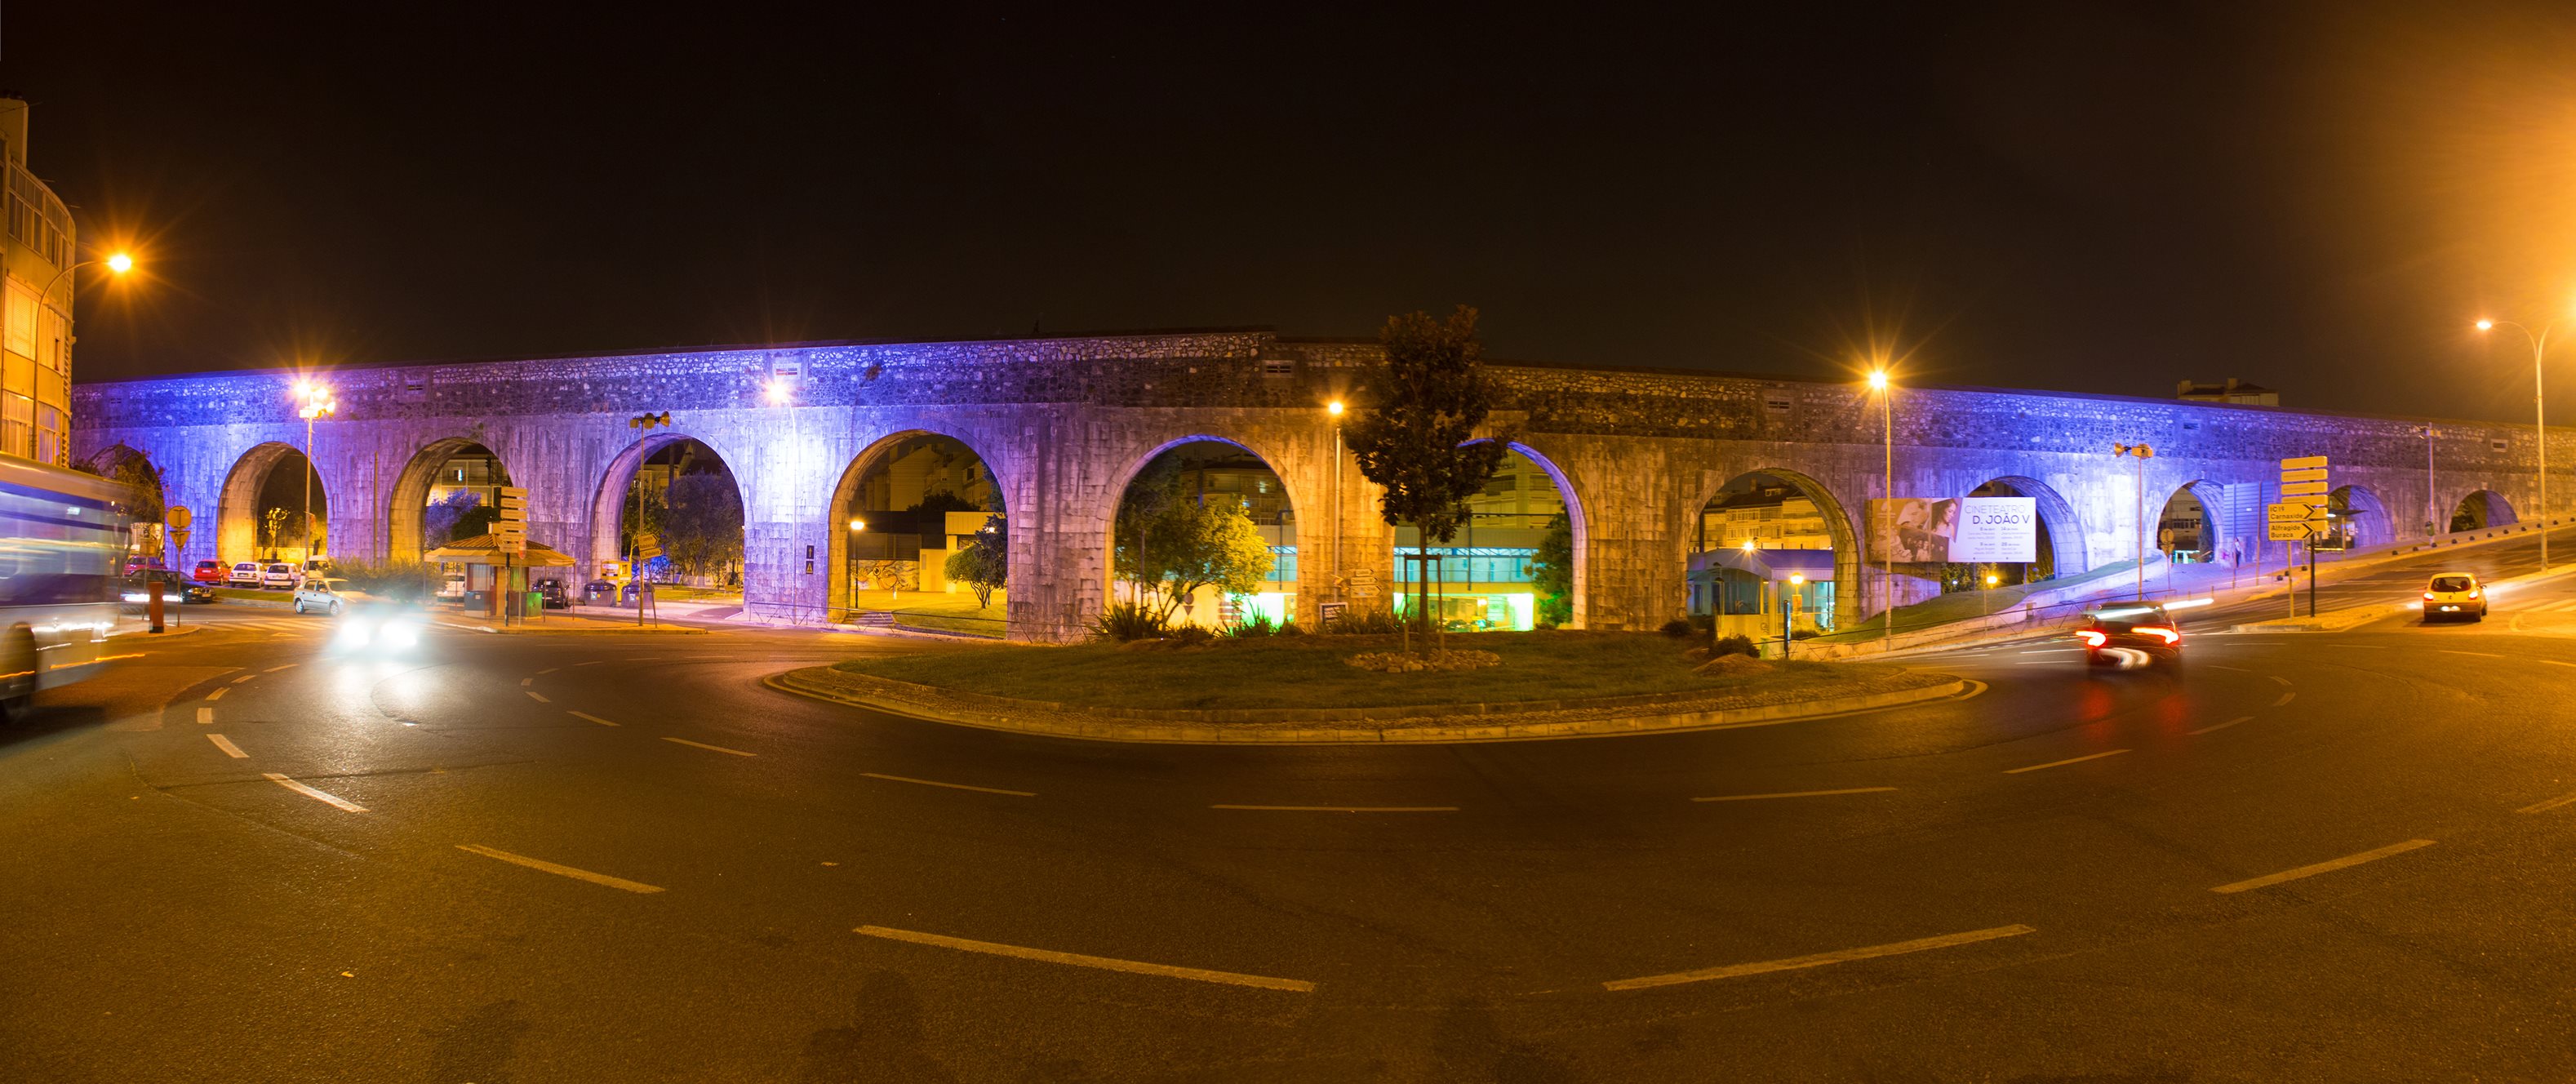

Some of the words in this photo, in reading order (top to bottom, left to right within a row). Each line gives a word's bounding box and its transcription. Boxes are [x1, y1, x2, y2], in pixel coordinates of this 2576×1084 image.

[1965, 504, 2025, 514] CINETEATRO
[1973, 515, 1983, 524] D.
[1985, 513, 2019, 524] JOÃO
[2022, 514, 2030, 524] V
